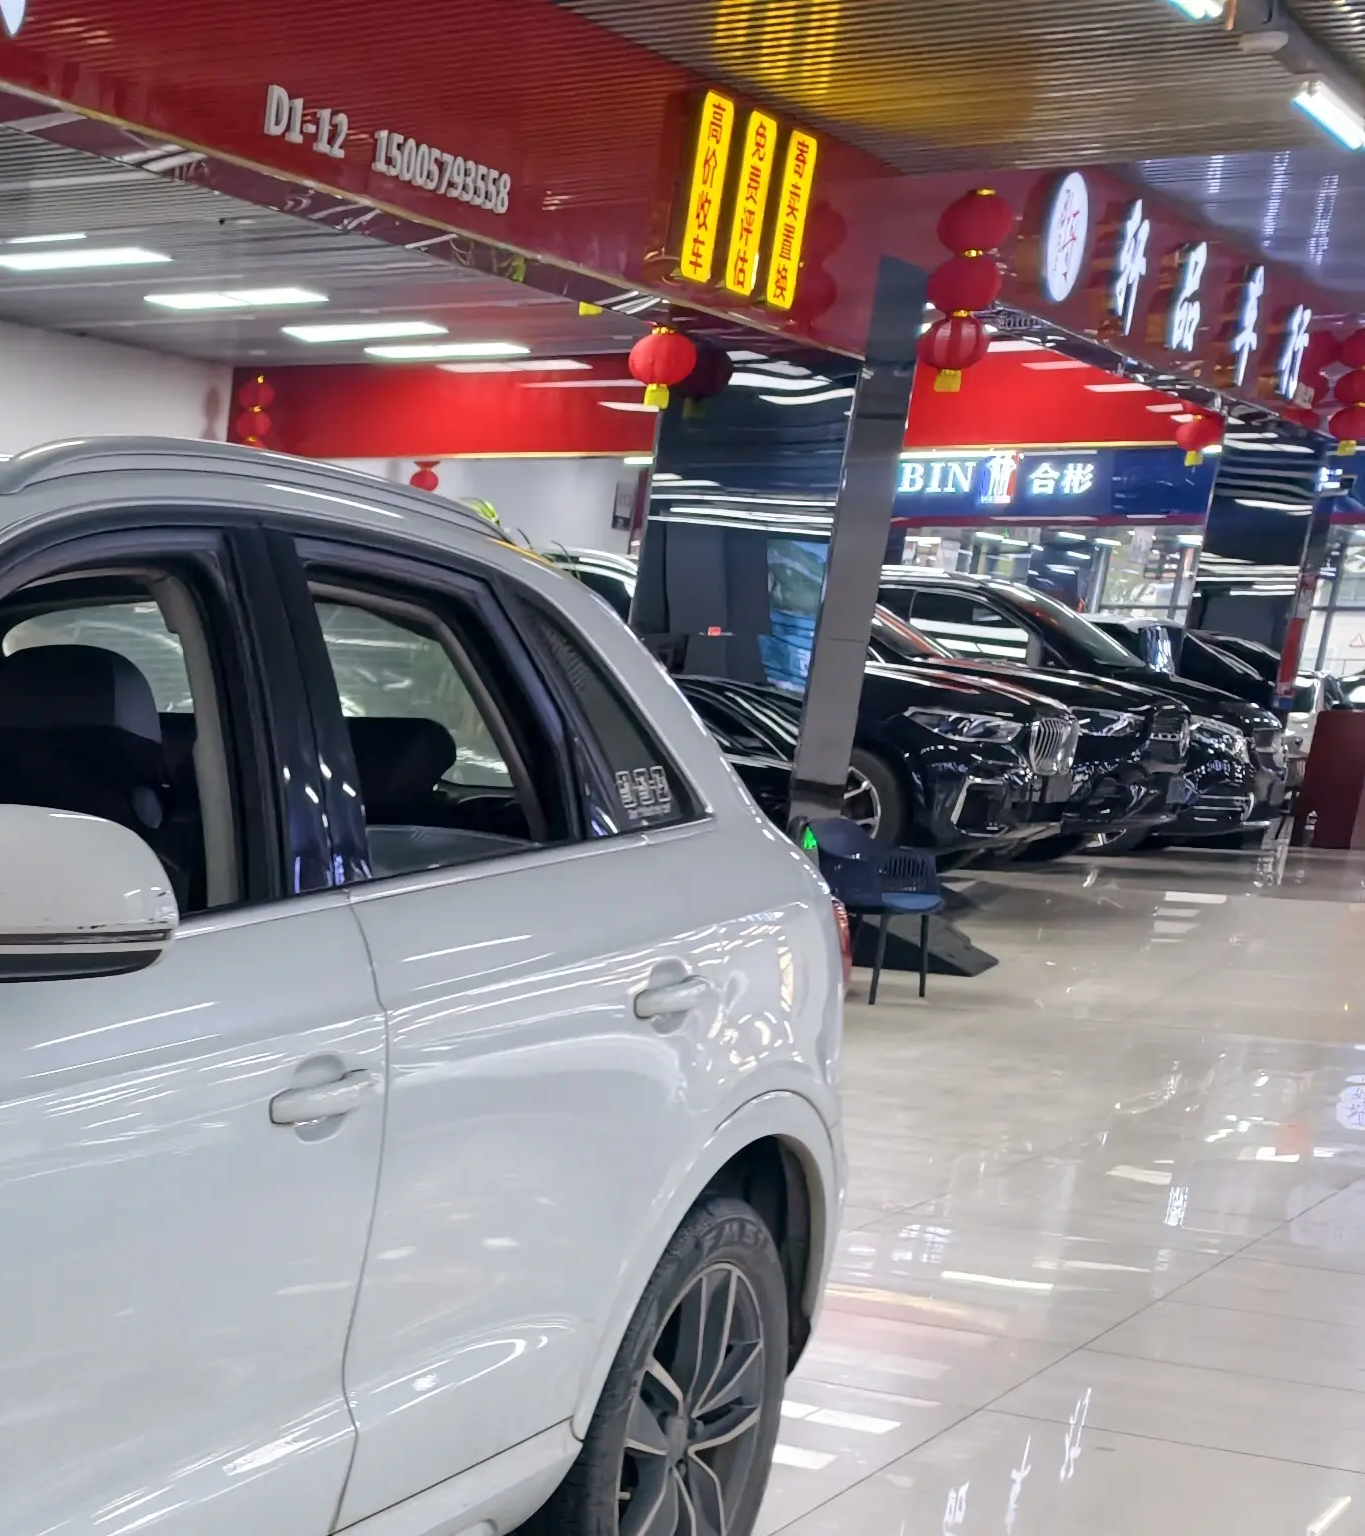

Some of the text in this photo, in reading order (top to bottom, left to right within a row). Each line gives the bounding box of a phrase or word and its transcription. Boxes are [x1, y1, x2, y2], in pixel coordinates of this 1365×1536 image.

[264, 84, 511, 214] D1-12 15005793558
[689, 102, 727, 275] 高价收车
[733, 121, 768, 289] 免费评估
[897, 461, 977, 493] BIN
[1028, 462, 1096, 495] 合彬
